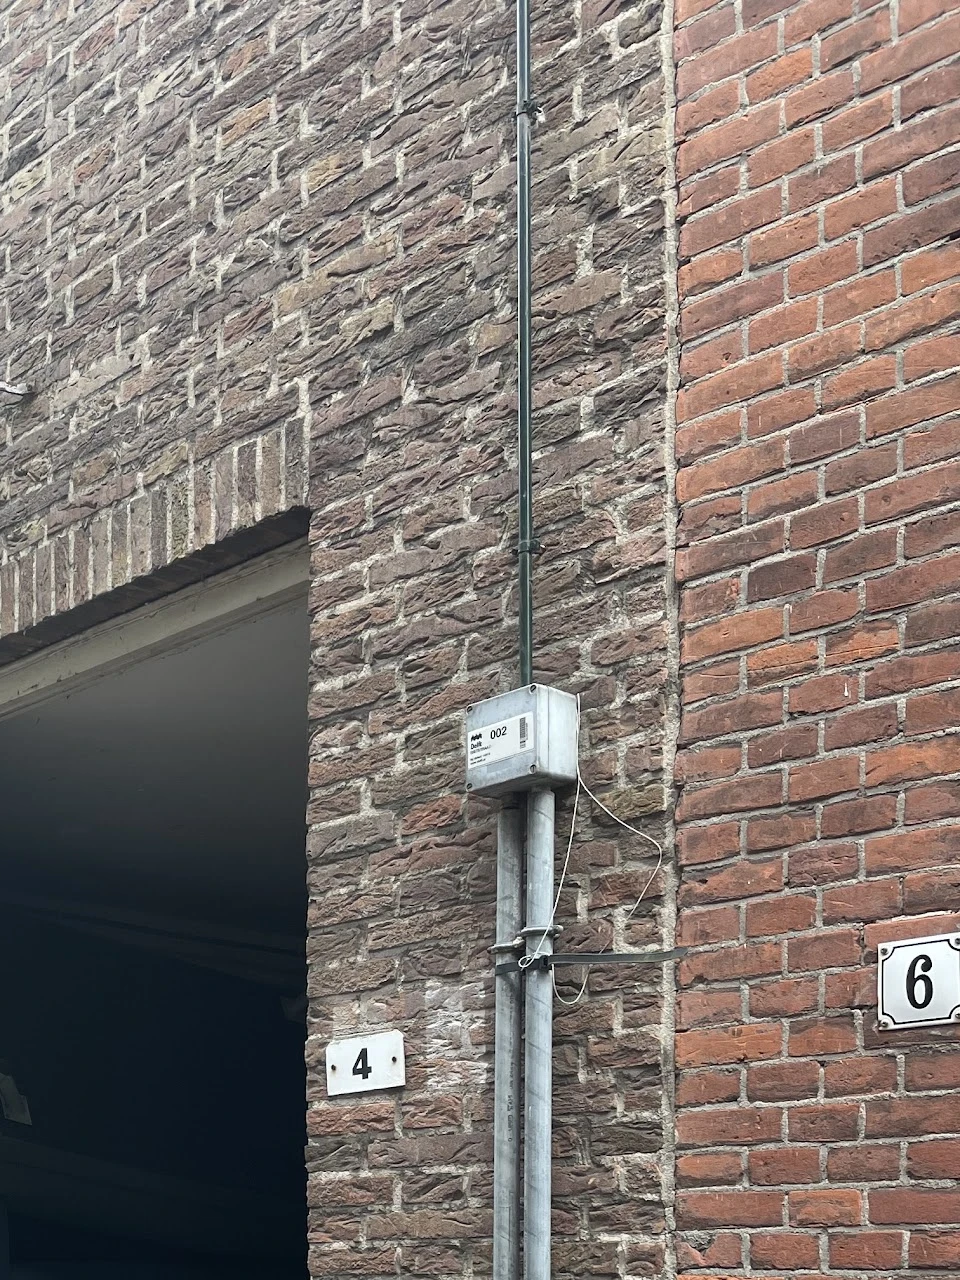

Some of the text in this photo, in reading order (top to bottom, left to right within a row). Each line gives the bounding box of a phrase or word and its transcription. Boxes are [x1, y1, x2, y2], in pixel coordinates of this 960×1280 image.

[490, 726, 507, 740] 002
[906, 954, 933, 1009] 6
[352, 1048, 372, 1080] 4
